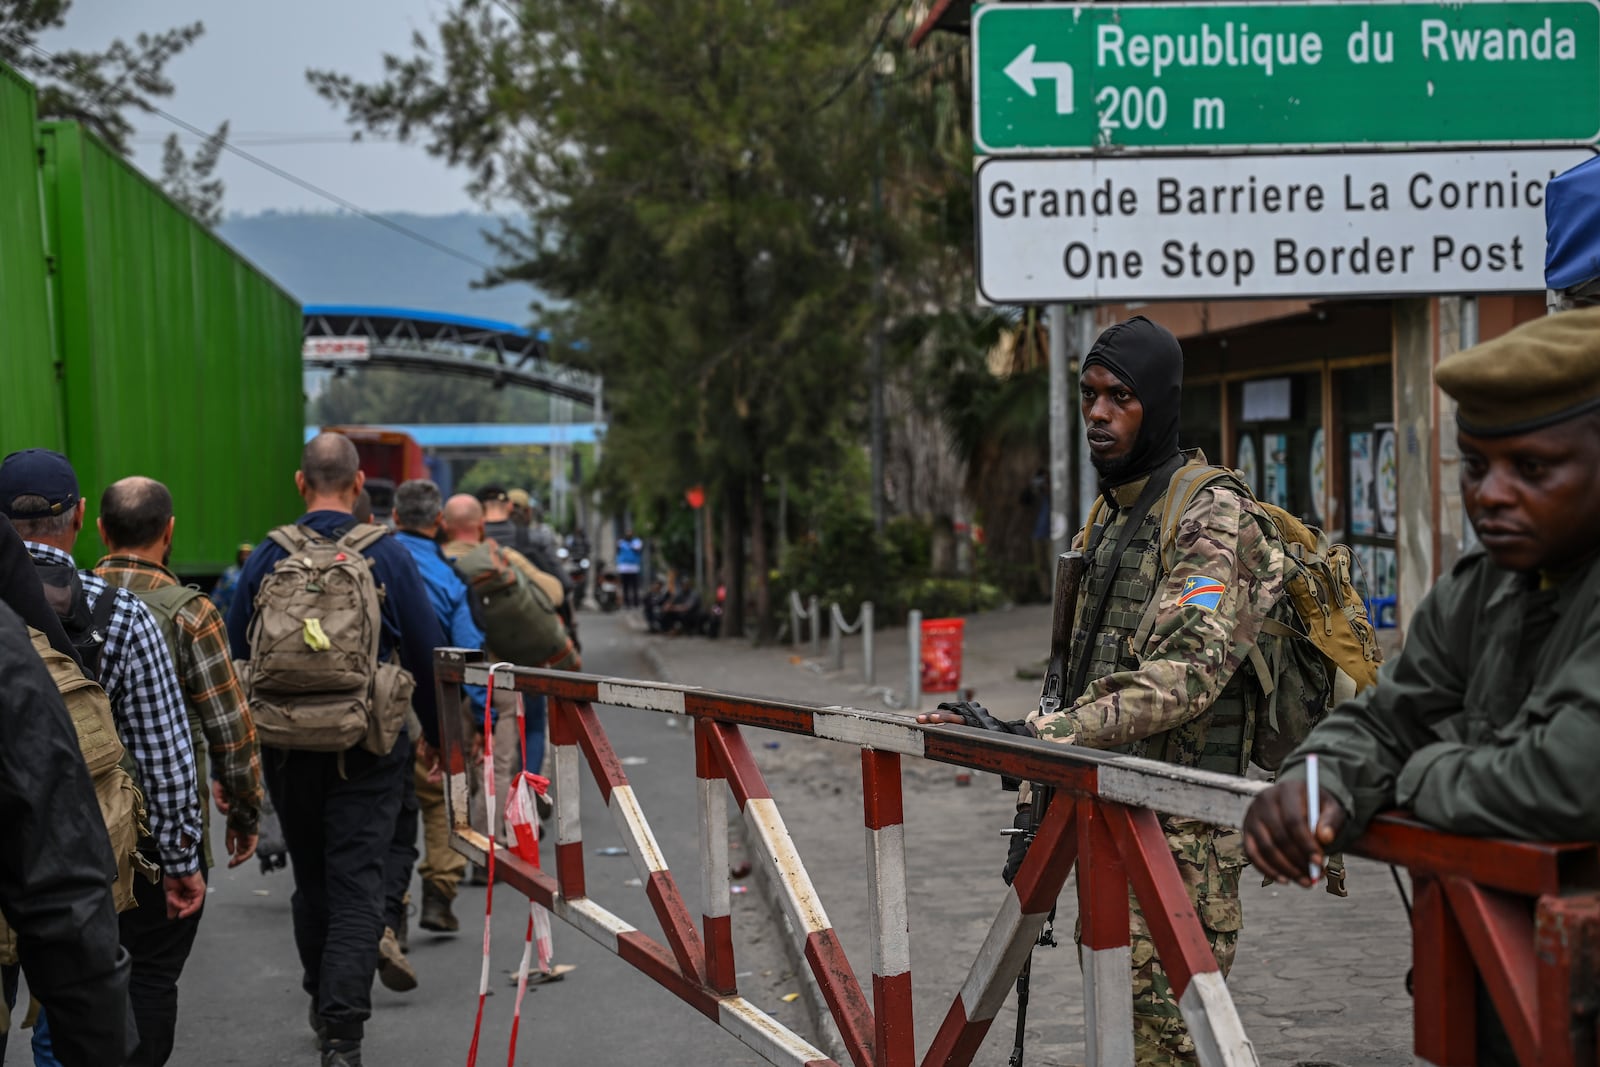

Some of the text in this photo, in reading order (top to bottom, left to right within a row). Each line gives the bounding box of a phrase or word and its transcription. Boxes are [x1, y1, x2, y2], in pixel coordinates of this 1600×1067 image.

[1096, 17, 1576, 77] Republique du Rwanda
[1098, 86, 1225, 130] 200 m
[988, 170, 1556, 219] Grande Barriere La Cornic
[1063, 235, 1524, 287] One Stop Border Post
